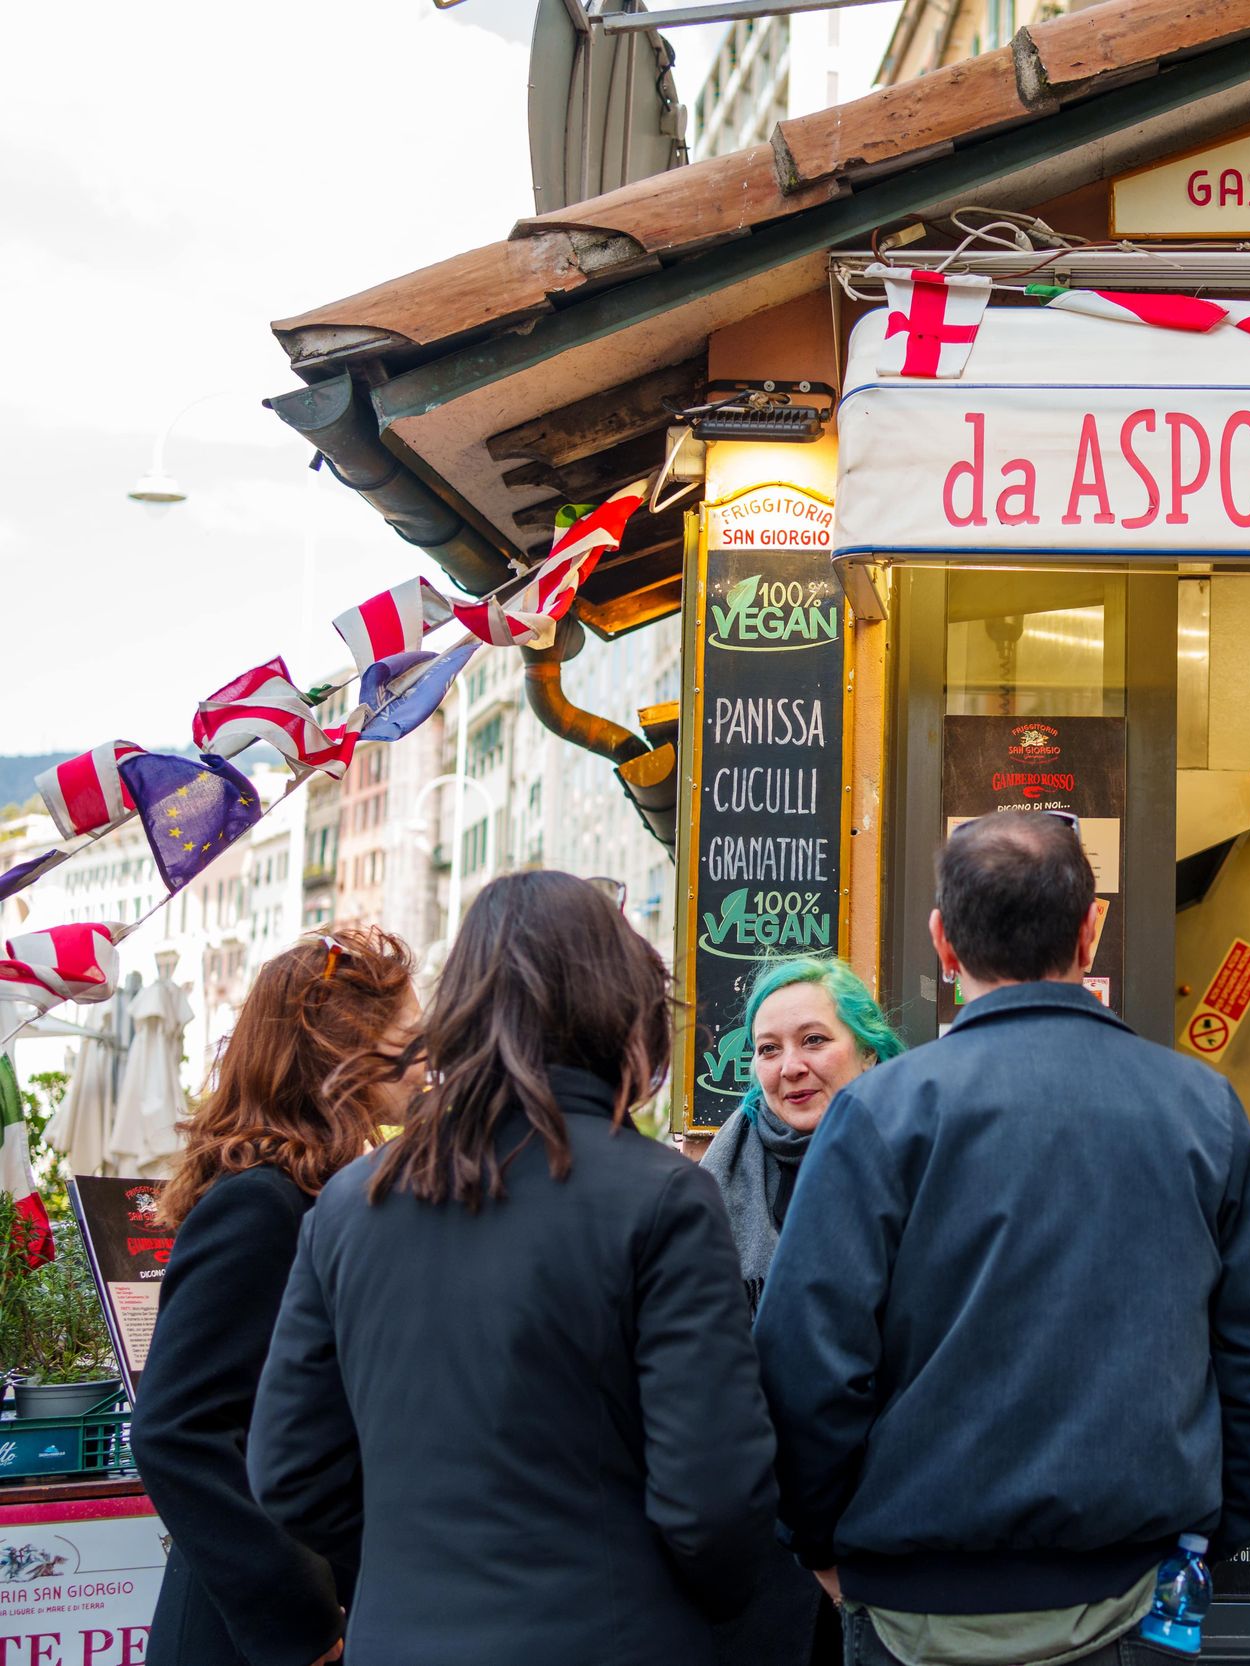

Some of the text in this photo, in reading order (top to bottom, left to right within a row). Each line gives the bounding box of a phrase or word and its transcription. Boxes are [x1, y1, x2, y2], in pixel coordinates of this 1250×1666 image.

[942, 412, 1041, 528] da
[721, 498, 833, 528] FRIGGITORIA
[722, 528, 830, 546] SAN GIORGIO
[758, 581, 823, 609] 100%
[711, 605, 838, 641] VEGAN
[715, 698, 825, 748] PANISSA
[1011, 724, 1059, 737] FRIGGITORIA
[1008, 746, 1061, 755] SAN GIORGIO
[713, 767, 817, 815] CUCULLI
[991, 772, 1075, 792] GAMBERO ROSSO
[1033, 802, 1043, 811] DI
[709, 835, 829, 882] GRANATINE
[753, 891, 822, 916] 100%
[703, 911, 830, 946] VEGAN
[33, 1585, 62, 1602] SAN
[67, 1581, 134, 1598] GIORGIO
[9, 1607, 35, 1616] LIGURE
[46, 1604, 65, 1613] MARE
[81, 1602, 105, 1610] TERRA
